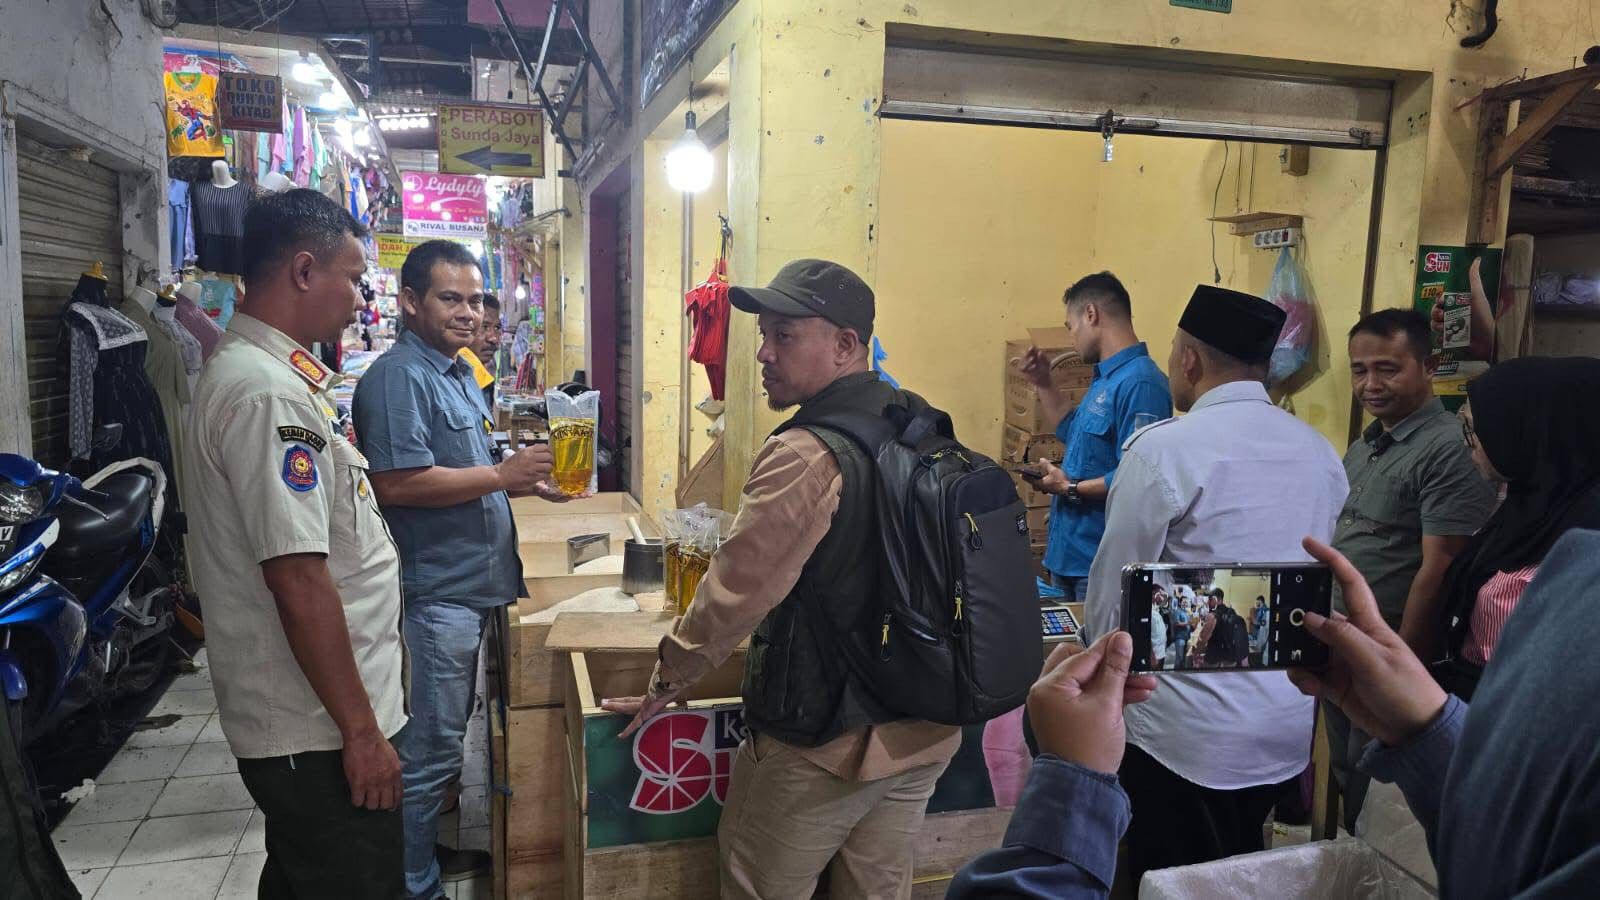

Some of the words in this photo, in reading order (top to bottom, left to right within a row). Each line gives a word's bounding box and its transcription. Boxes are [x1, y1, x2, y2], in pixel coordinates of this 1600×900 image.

[224, 77, 275, 93] TOKO
[231, 105, 271, 118] KITAB
[449, 108, 537, 126] PERABOT
[451, 127, 500, 143] Sunda
[503, 129, 540, 147] Jaya
[420, 222, 447, 231] RIVAL
